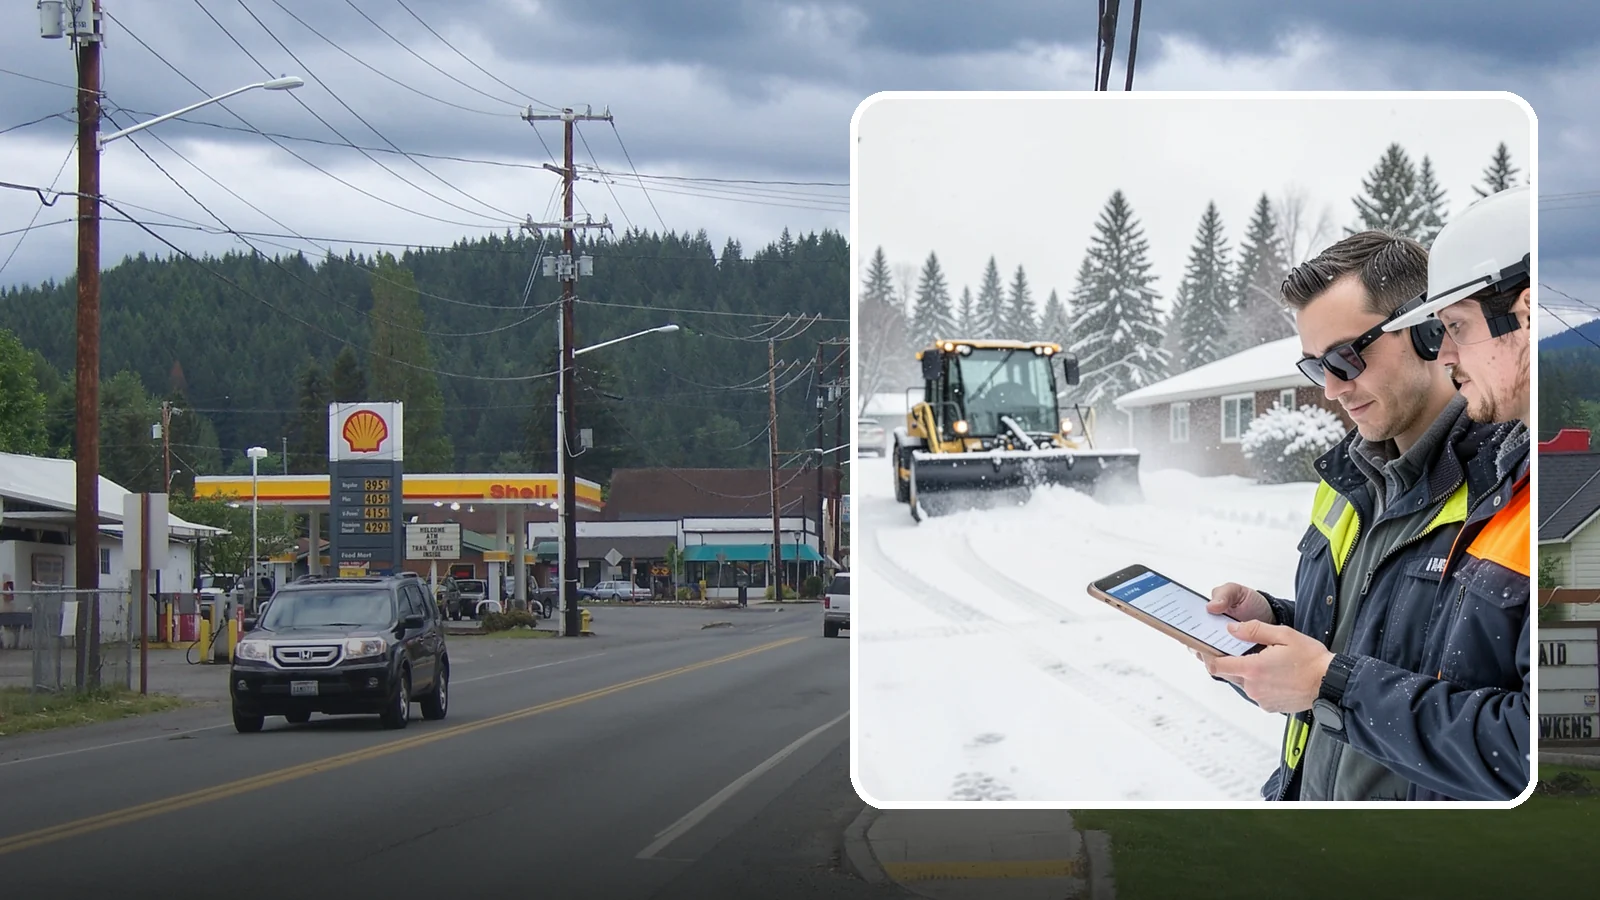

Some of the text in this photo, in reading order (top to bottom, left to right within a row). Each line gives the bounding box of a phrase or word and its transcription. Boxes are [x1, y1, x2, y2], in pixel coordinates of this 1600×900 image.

[489, 484, 548, 498] Shell
[365, 494, 384, 504] 405
[365, 508, 384, 518] 415
[366, 522, 384, 532] 429
